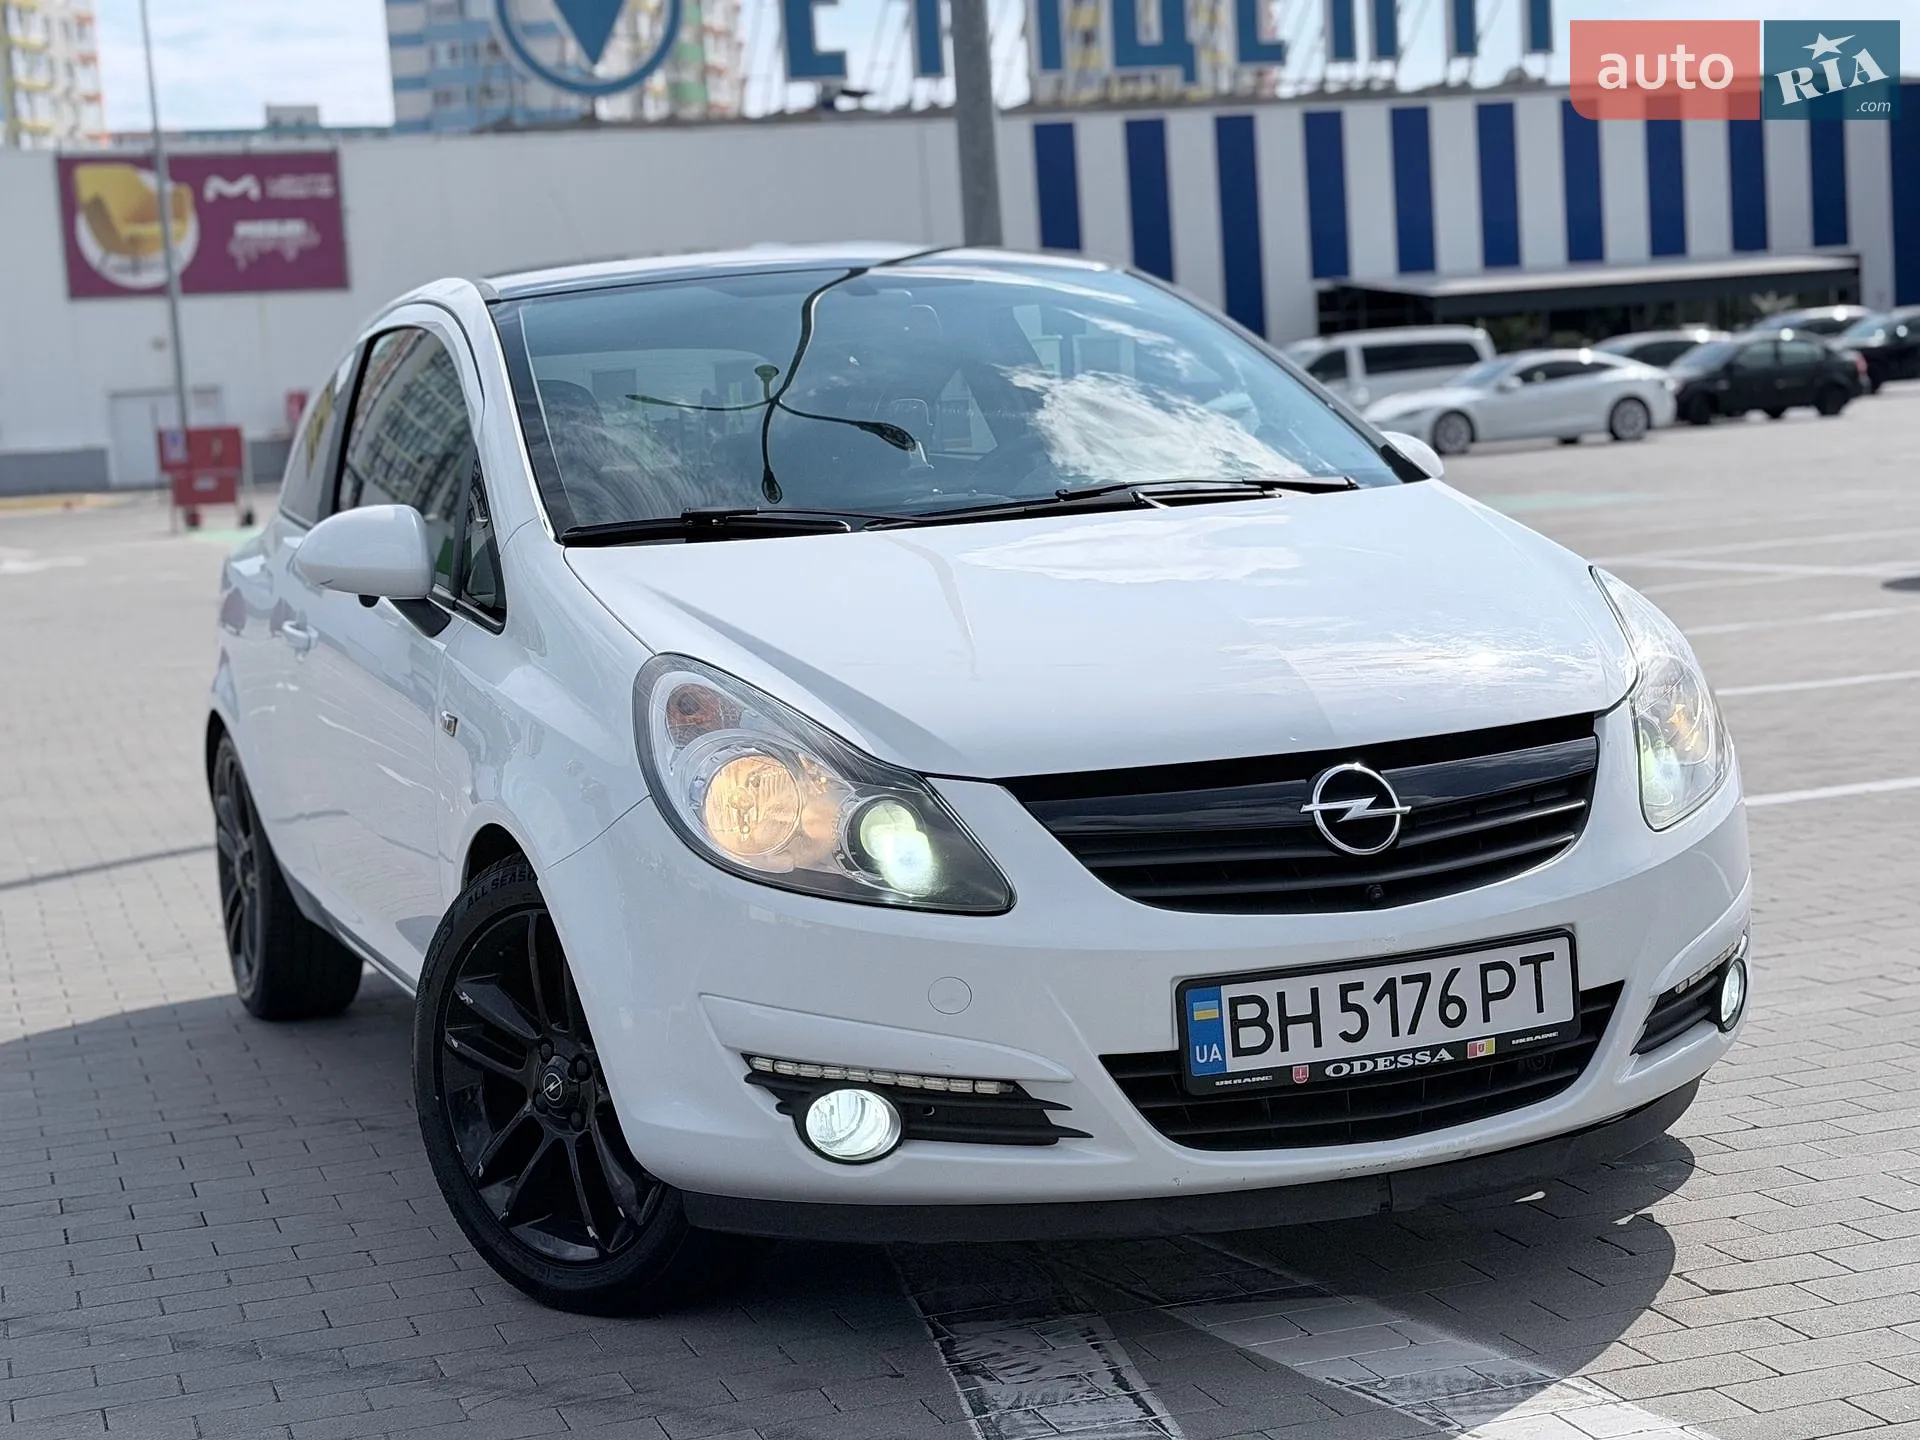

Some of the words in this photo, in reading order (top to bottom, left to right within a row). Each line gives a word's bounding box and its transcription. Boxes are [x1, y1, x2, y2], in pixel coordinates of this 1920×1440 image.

[490, 869, 538, 890] SEASO
[1228, 987, 1323, 1058] BH
[1338, 967, 1467, 1043] 5176
[1479, 951, 1555, 1023] PT
[1195, 1043, 1223, 1063] UA
[1215, 1075, 1272, 1086] UKRAINE
[1324, 1047, 1455, 1077] ODESSA
[1511, 1031, 1559, 1045] UKRAINE
